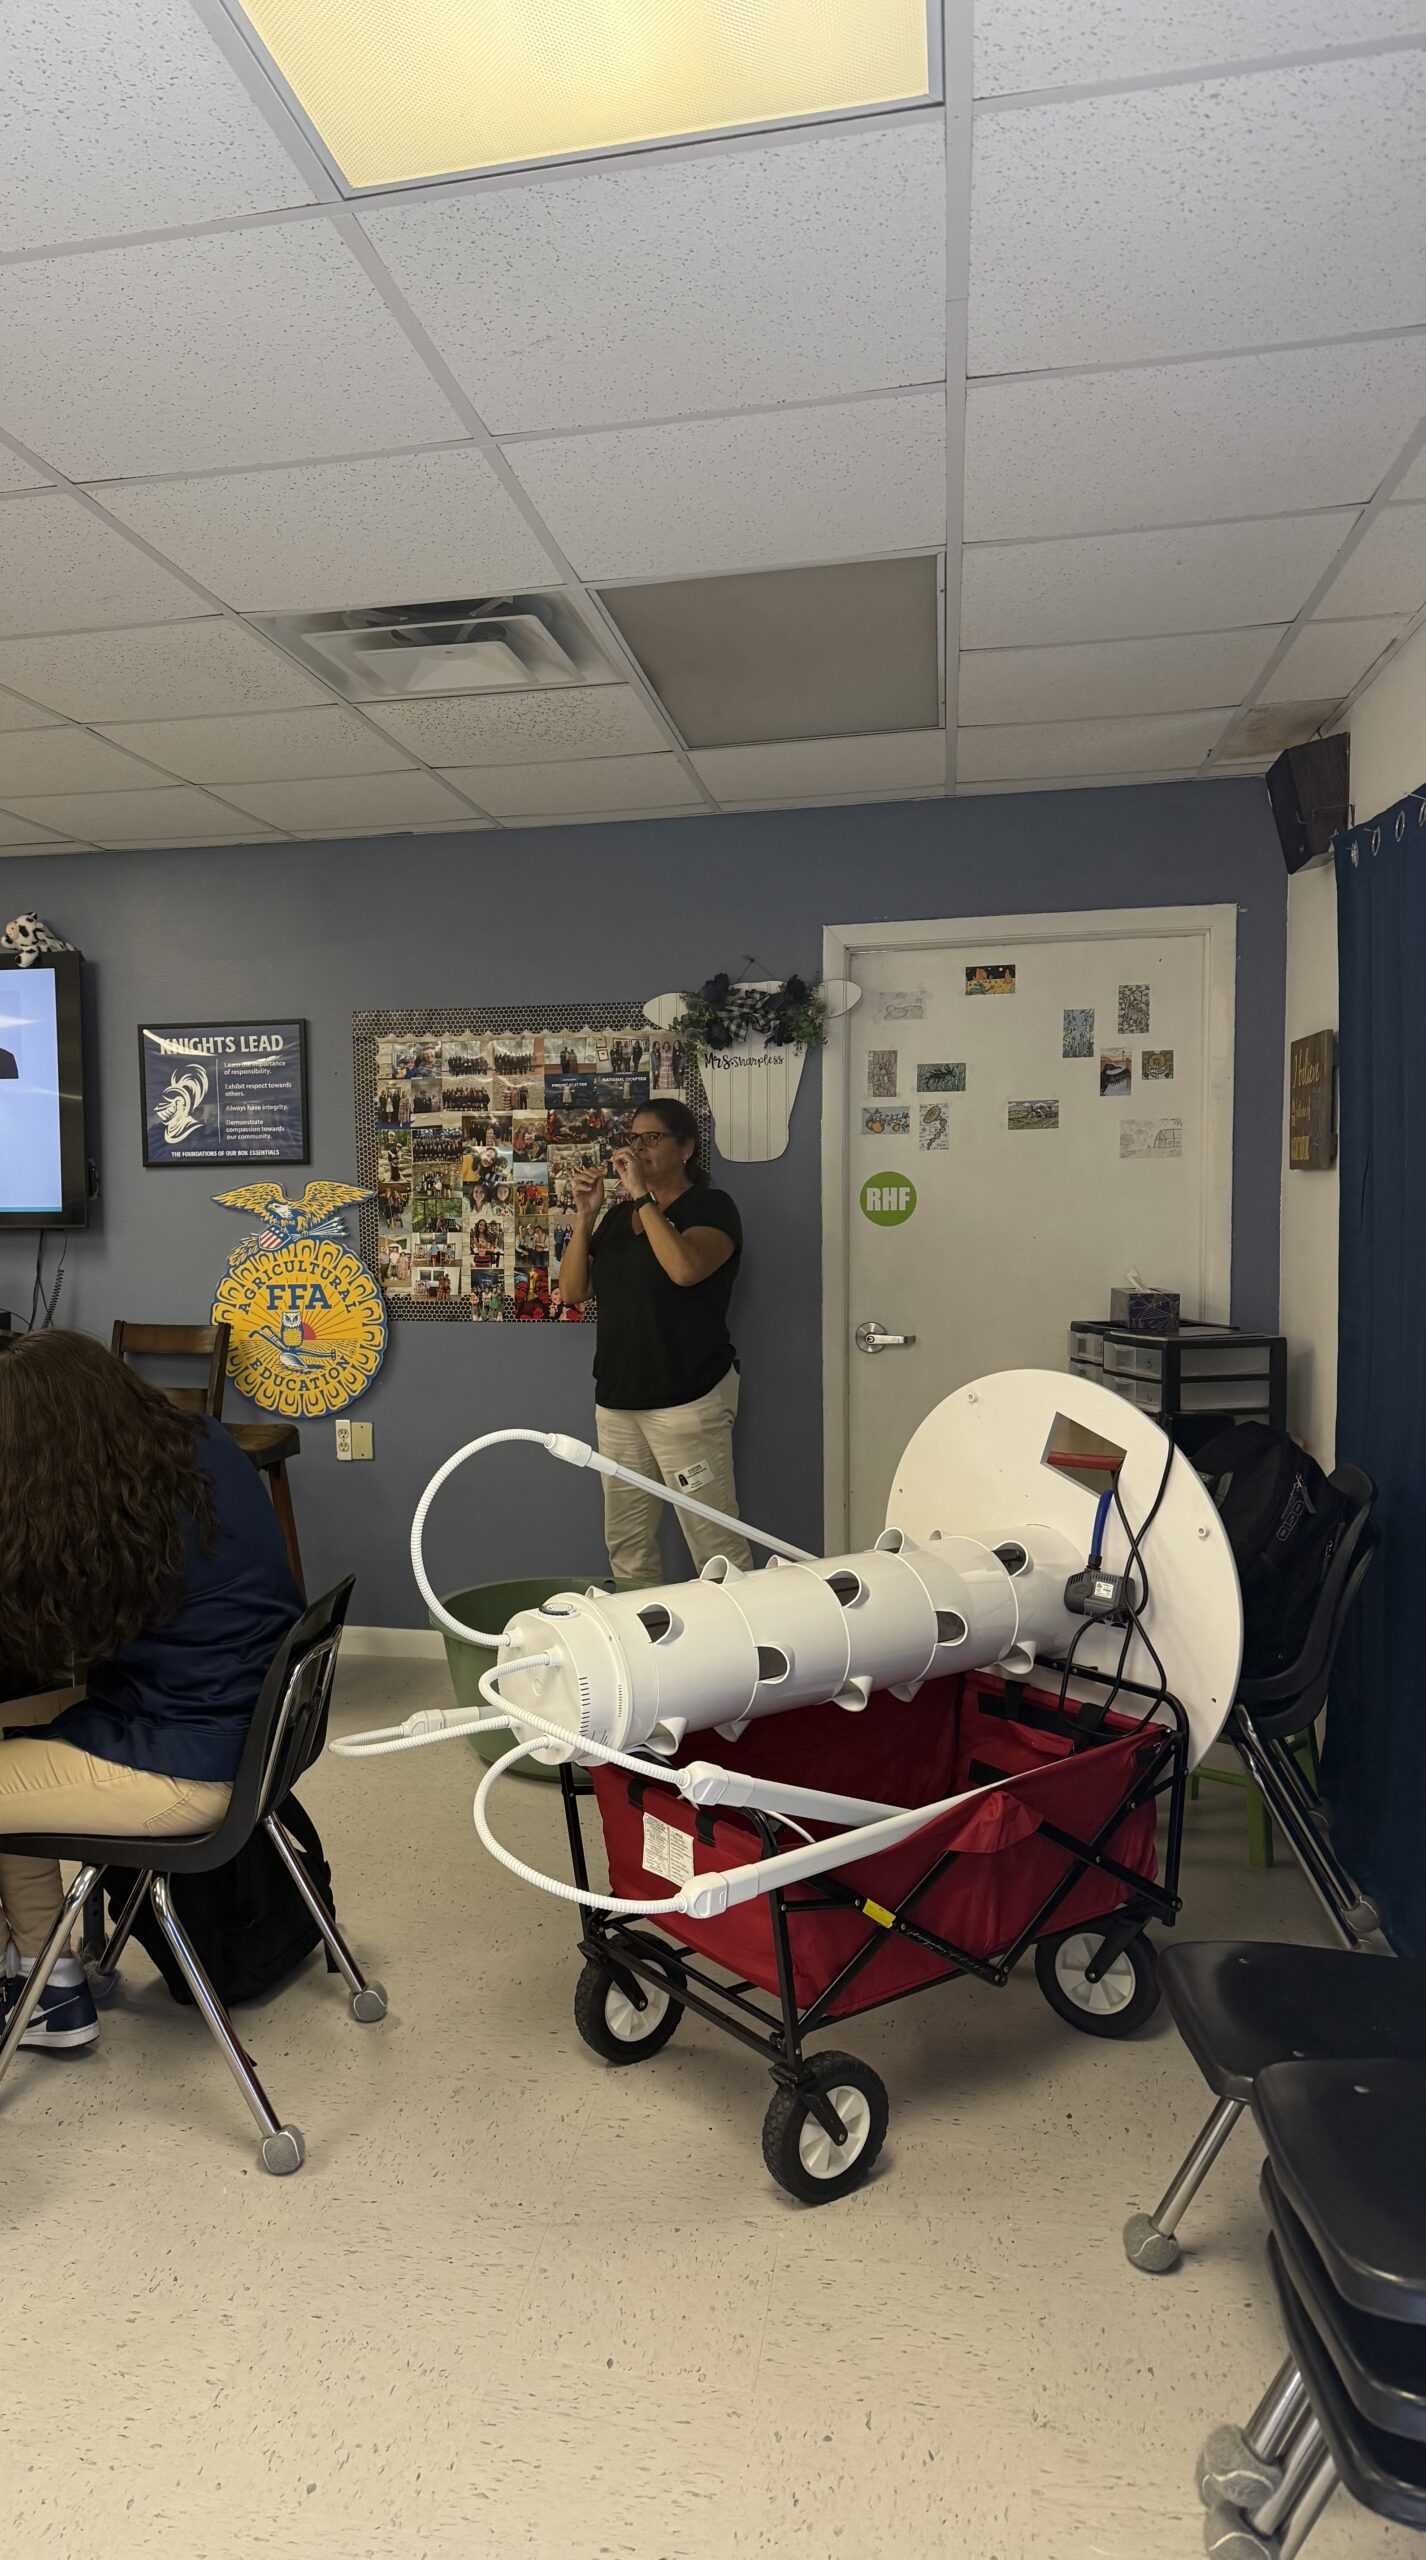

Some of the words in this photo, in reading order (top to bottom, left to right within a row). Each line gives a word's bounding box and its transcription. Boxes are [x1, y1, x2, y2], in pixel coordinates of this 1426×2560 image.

[161, 1036, 236, 1055] KNIGHTS
[240, 1034, 284, 1053] LEAD
[224, 1068, 231, 1076] of
[231, 1068, 272, 1077] responsibility.
[245, 1082, 268, 1090] respect
[268, 1081, 292, 1089] towards
[225, 1105, 247, 1113] Always
[246, 1104, 261, 1112] have
[262, 1103, 289, 1112] integrity.
[237, 1133, 272, 1141] community.
[181, 1150, 217, 1158] FOUNDATIONS
[866, 1186, 911, 1212] RHF
[238, 1260, 359, 1315] AGRICULTURAL
[266, 1283, 333, 1311] FFA
[249, 1355, 351, 1392] EDUCATION
